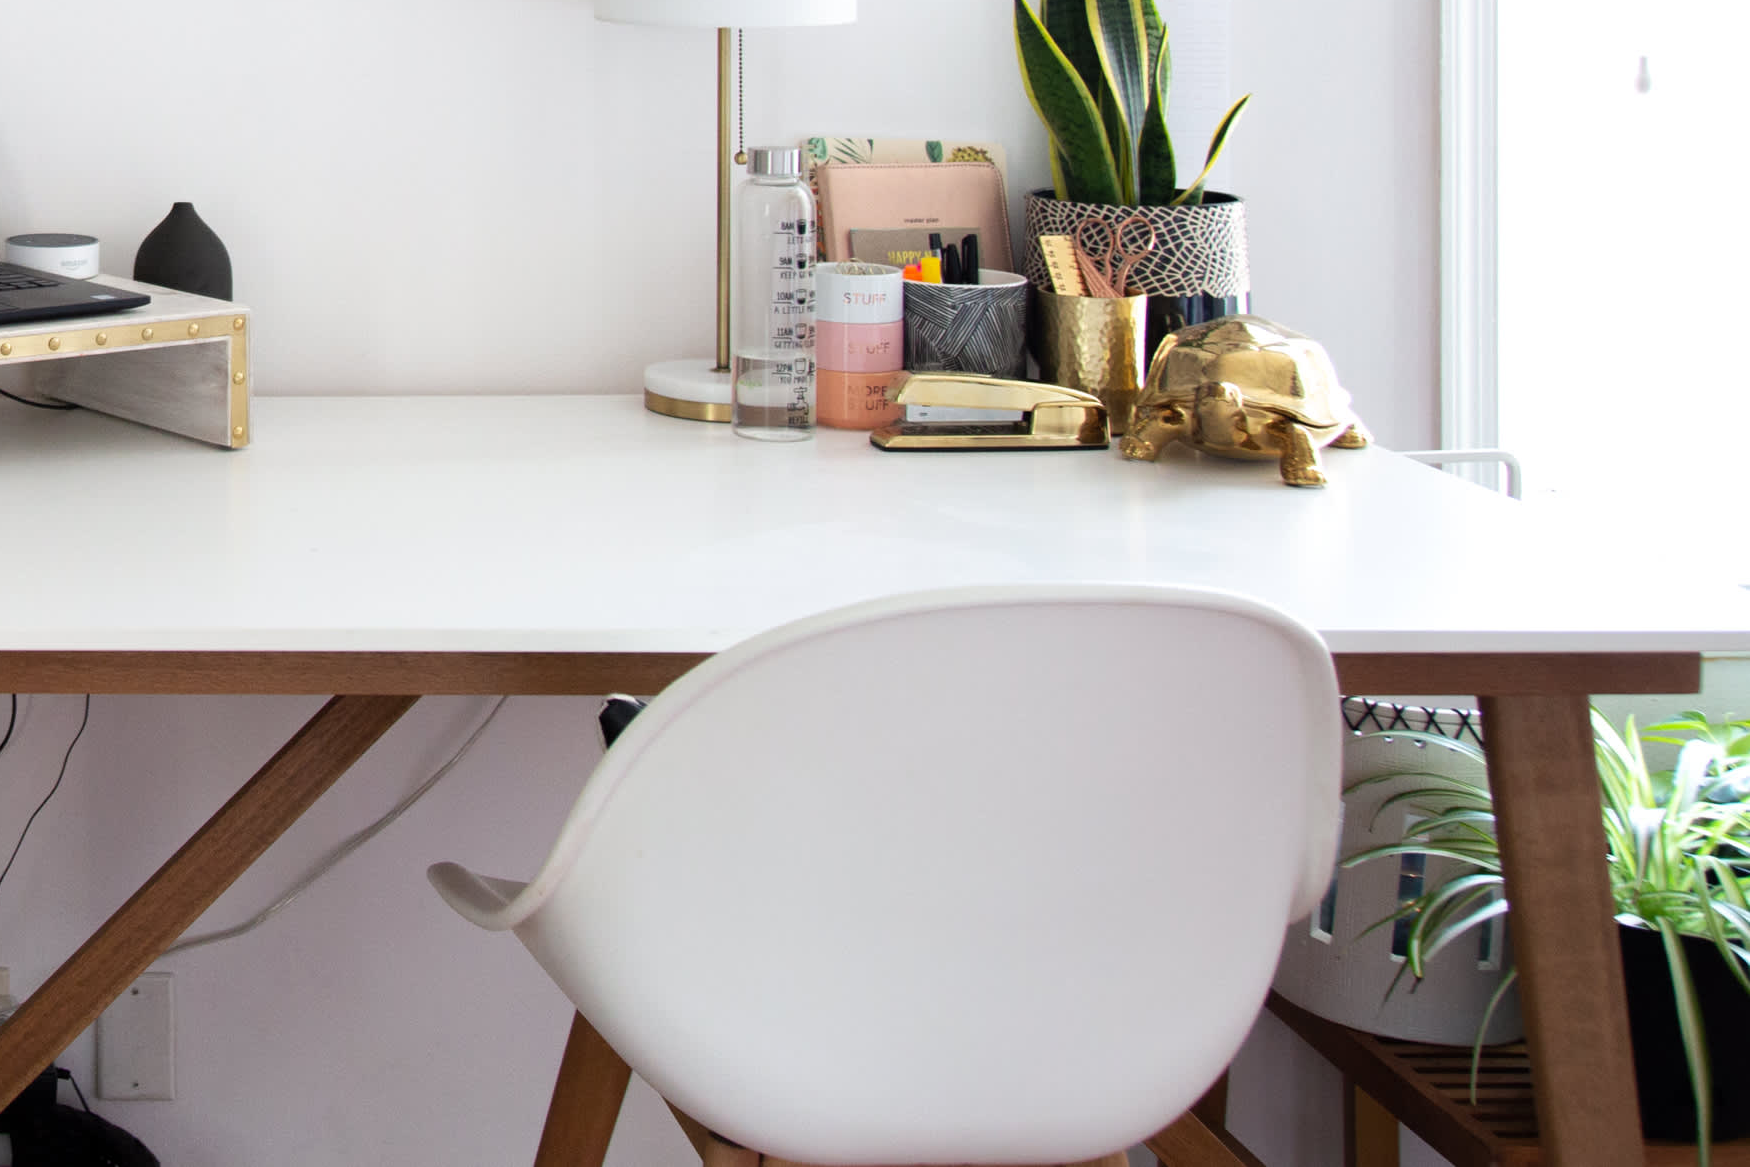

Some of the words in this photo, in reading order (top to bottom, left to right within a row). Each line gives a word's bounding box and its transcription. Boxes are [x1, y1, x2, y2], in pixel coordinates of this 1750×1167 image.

[887, 250, 922, 265] HAPPY
[843, 292, 887, 305] STUFF
[773, 306, 780, 314] A
